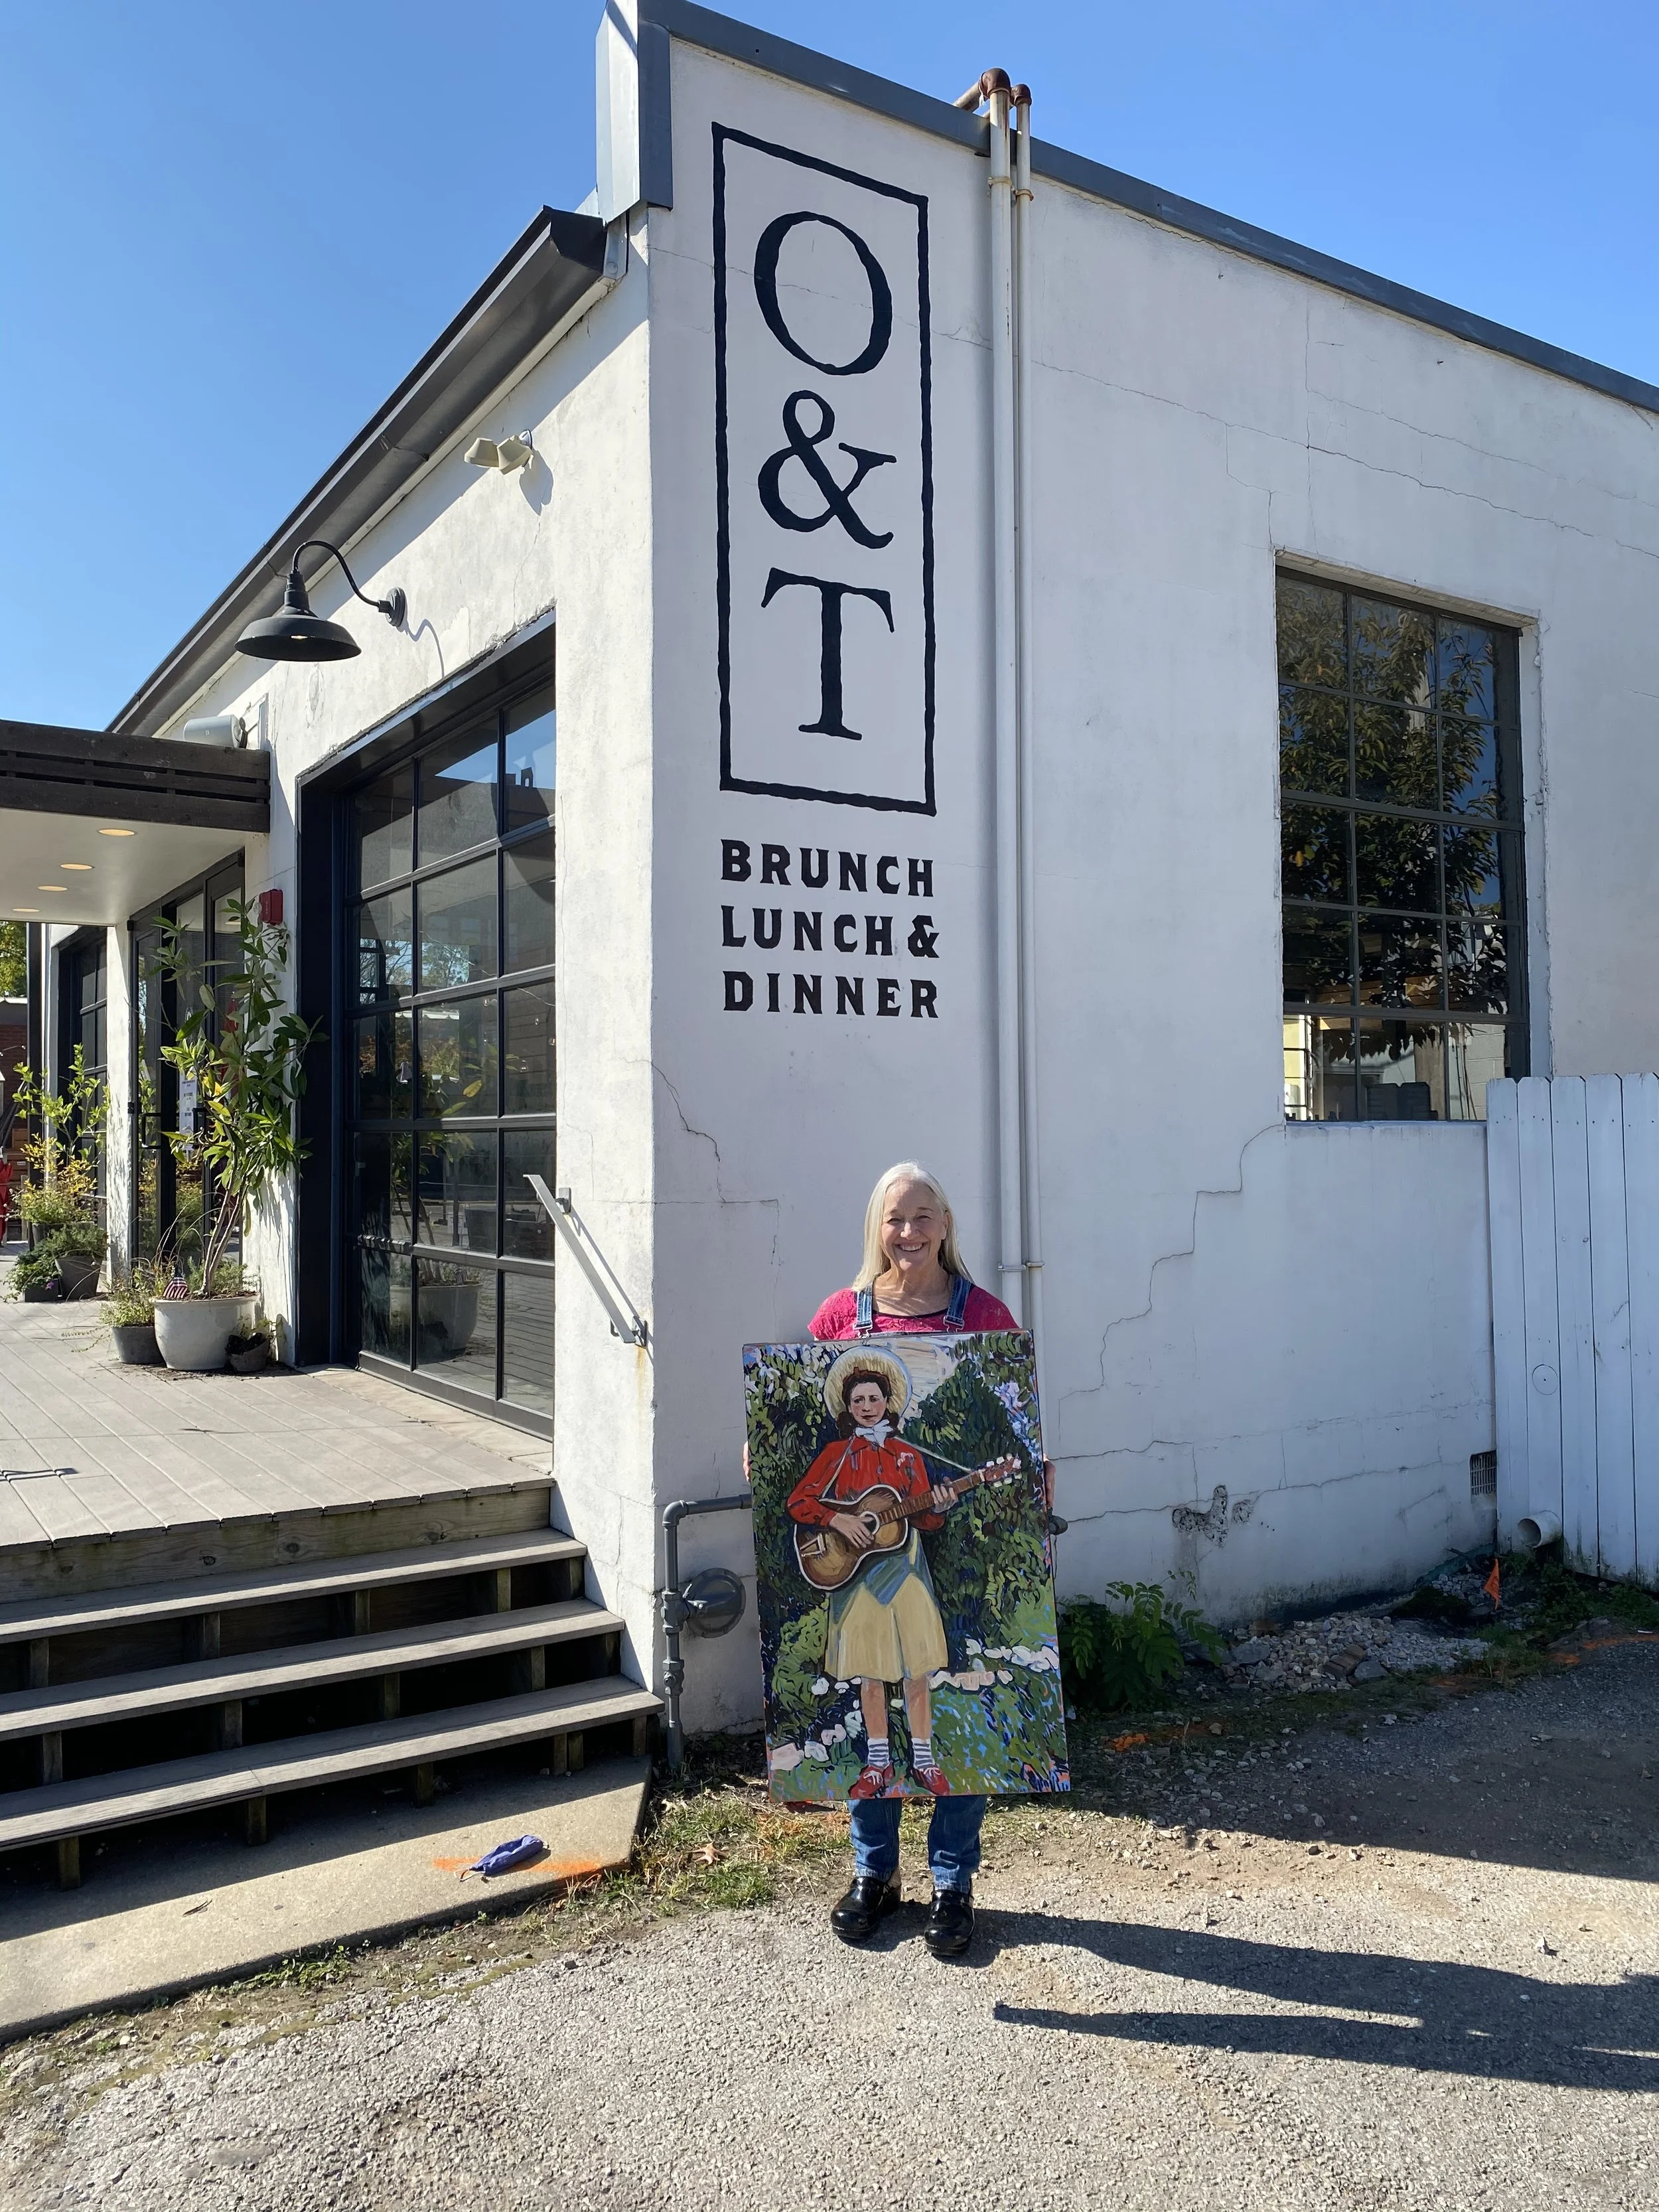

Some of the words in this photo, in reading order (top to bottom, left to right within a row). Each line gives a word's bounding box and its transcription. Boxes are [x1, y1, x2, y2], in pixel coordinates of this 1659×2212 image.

[754, 211, 893, 376] O
[757, 390, 897, 550] &
[760, 567, 895, 741] T
[720, 838, 934, 897] BRUNCH
[722, 970, 939, 1019] DINNER
